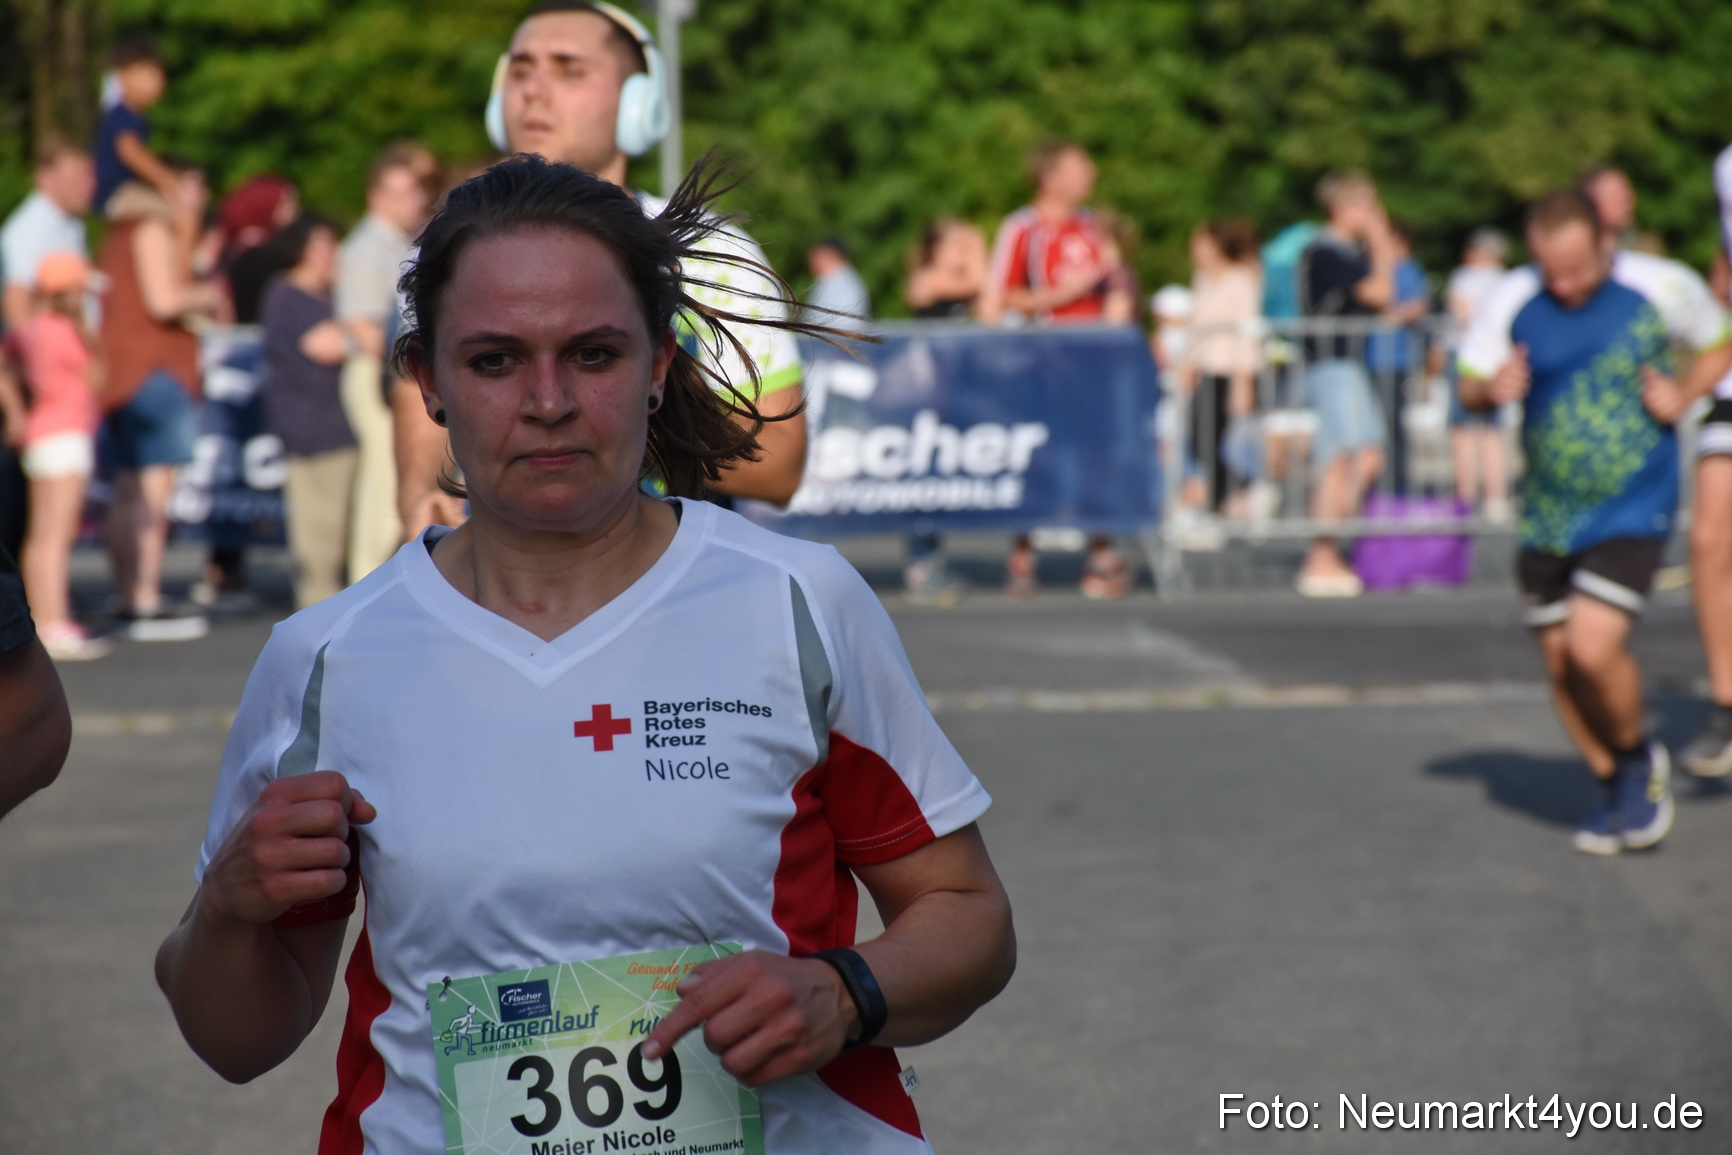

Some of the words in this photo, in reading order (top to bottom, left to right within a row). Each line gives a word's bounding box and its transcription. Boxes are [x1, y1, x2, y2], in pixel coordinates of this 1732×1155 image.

[643, 697, 773, 718] Bayerisches
[644, 716, 707, 732] Rotes
[645, 733, 707, 749] Kreuz
[645, 755, 731, 782] Nicole
[626, 960, 680, 976] Gesunde
[508, 991, 543, 1004] Fischer
[480, 1004, 600, 1043] firmenlauf
[482, 1037, 534, 1053] neumarkt
[506, 1040, 683, 1137] 369
[531, 1138, 596, 1155] Meier
[602, 1126, 677, 1152] Nicole
[689, 1139, 745, 1155] Neumarkt
